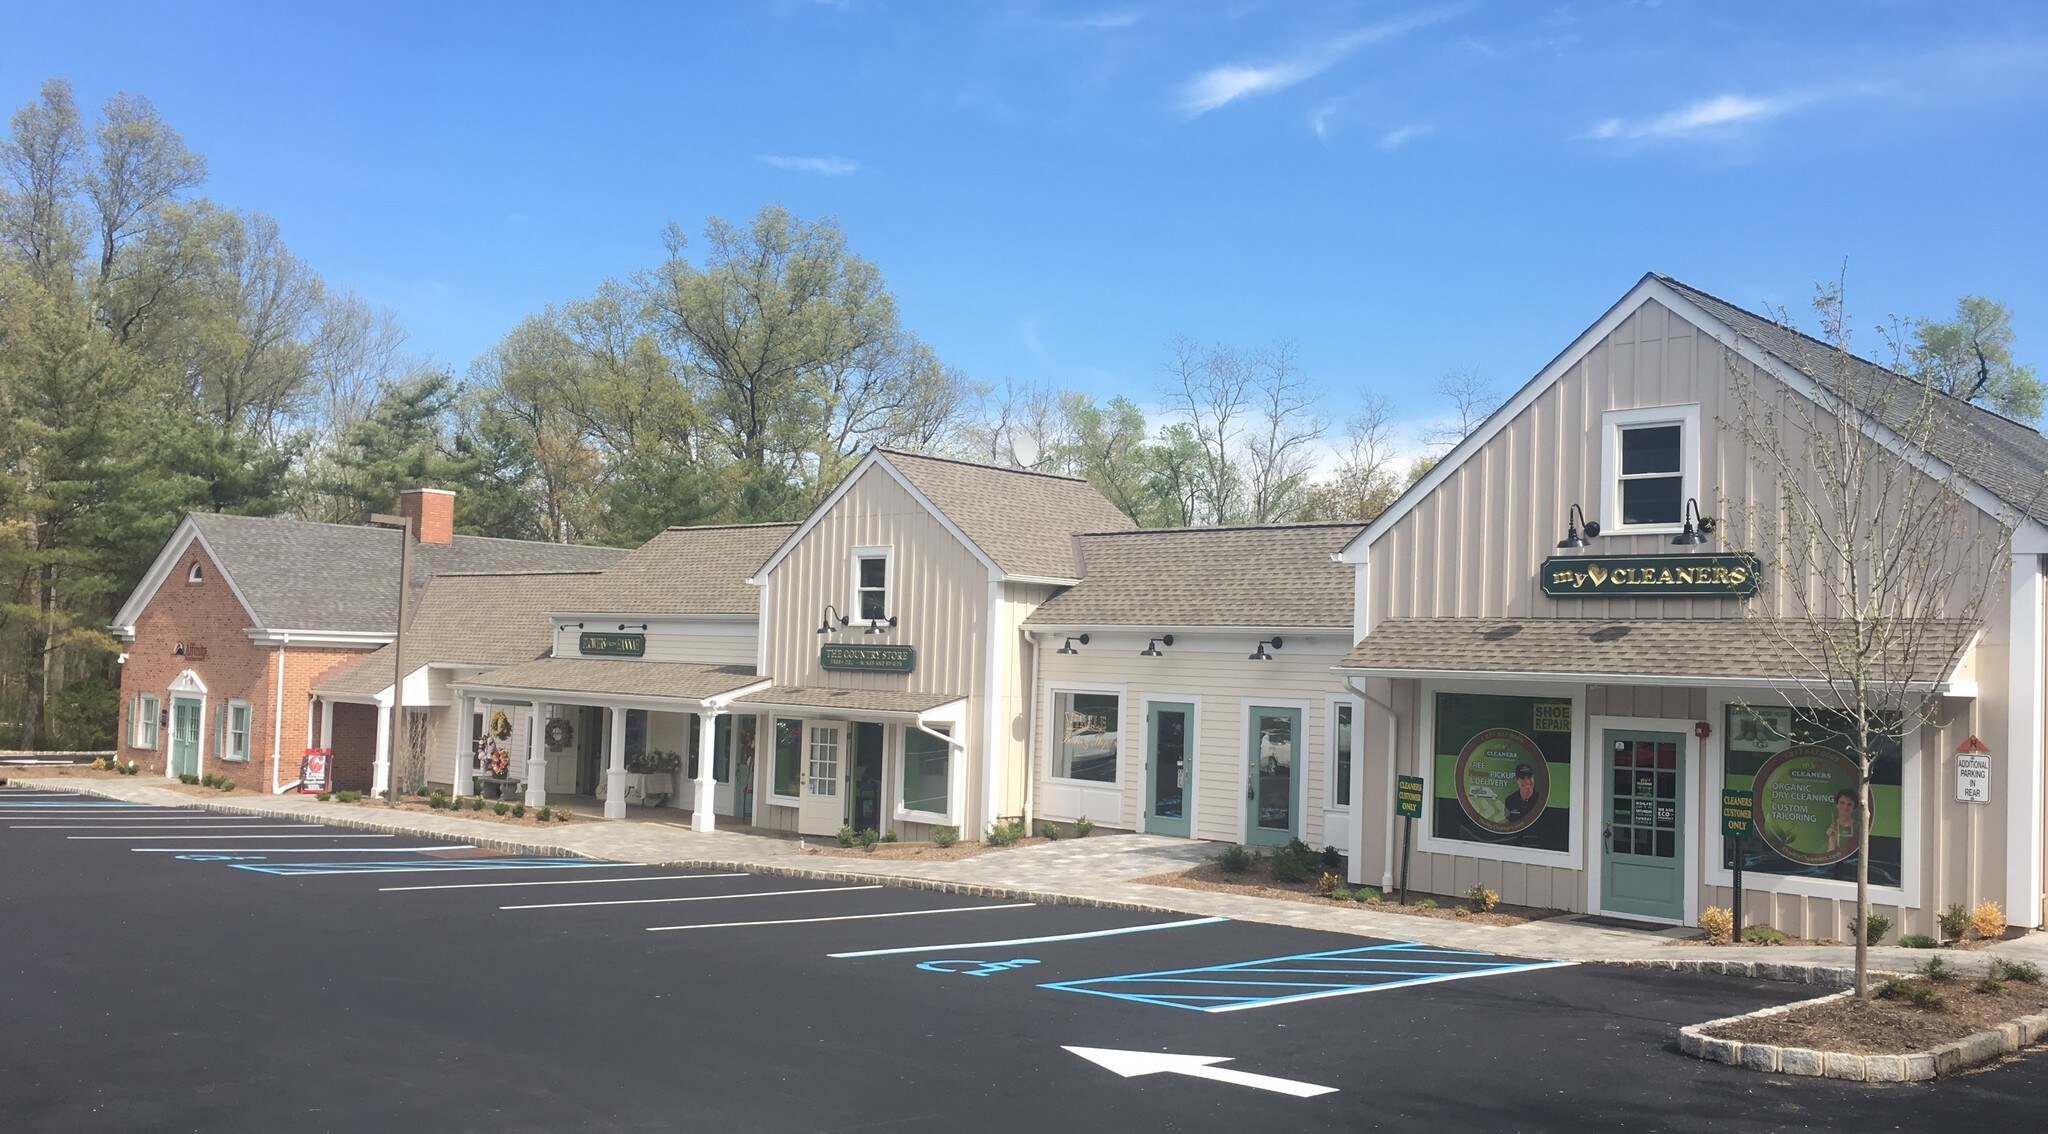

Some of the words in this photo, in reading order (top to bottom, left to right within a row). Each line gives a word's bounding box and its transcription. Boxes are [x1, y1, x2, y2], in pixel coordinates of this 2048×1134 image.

[1553, 570, 1588, 588] my
[1610, 567, 1747, 586] CLEANERS
[826, 649, 842, 659] THE
[843, 650, 881, 660] COUNTRY
[882, 651, 908, 661] STORE
[1535, 706, 1570, 719] SHOE
[1535, 718, 1570, 730] REPAIR
[1487, 751, 1518, 759] CLEANERS
[1470, 761, 1486, 769] FREE
[1959, 760, 1988, 769] ADDITIONAL
[1490, 771, 1516, 780] PICKUP
[1792, 770, 1832, 779] CLEANERS
[1960, 770, 1985, 778] PARKING
[1400, 781, 1422, 791] CLEANERS
[1475, 777, 1509, 787] DELIVERY
[1772, 782, 1811, 792] ORGANIC
[1399, 792, 1421, 801] CUSTOMER
[1772, 790, 1789, 799] DRY
[1790, 792, 1835, 803] CLEANING
[1965, 789, 1980, 797] REAR
[1724, 796, 1752, 806] CLEANERS
[1401, 803, 1417, 812] ONLY
[1771, 803, 1808, 813] CUSTOM
[1724, 808, 1752, 818] CUSTOMER
[1771, 811, 1817, 823] TAILORING
[1728, 821, 1746, 830] ONLY
